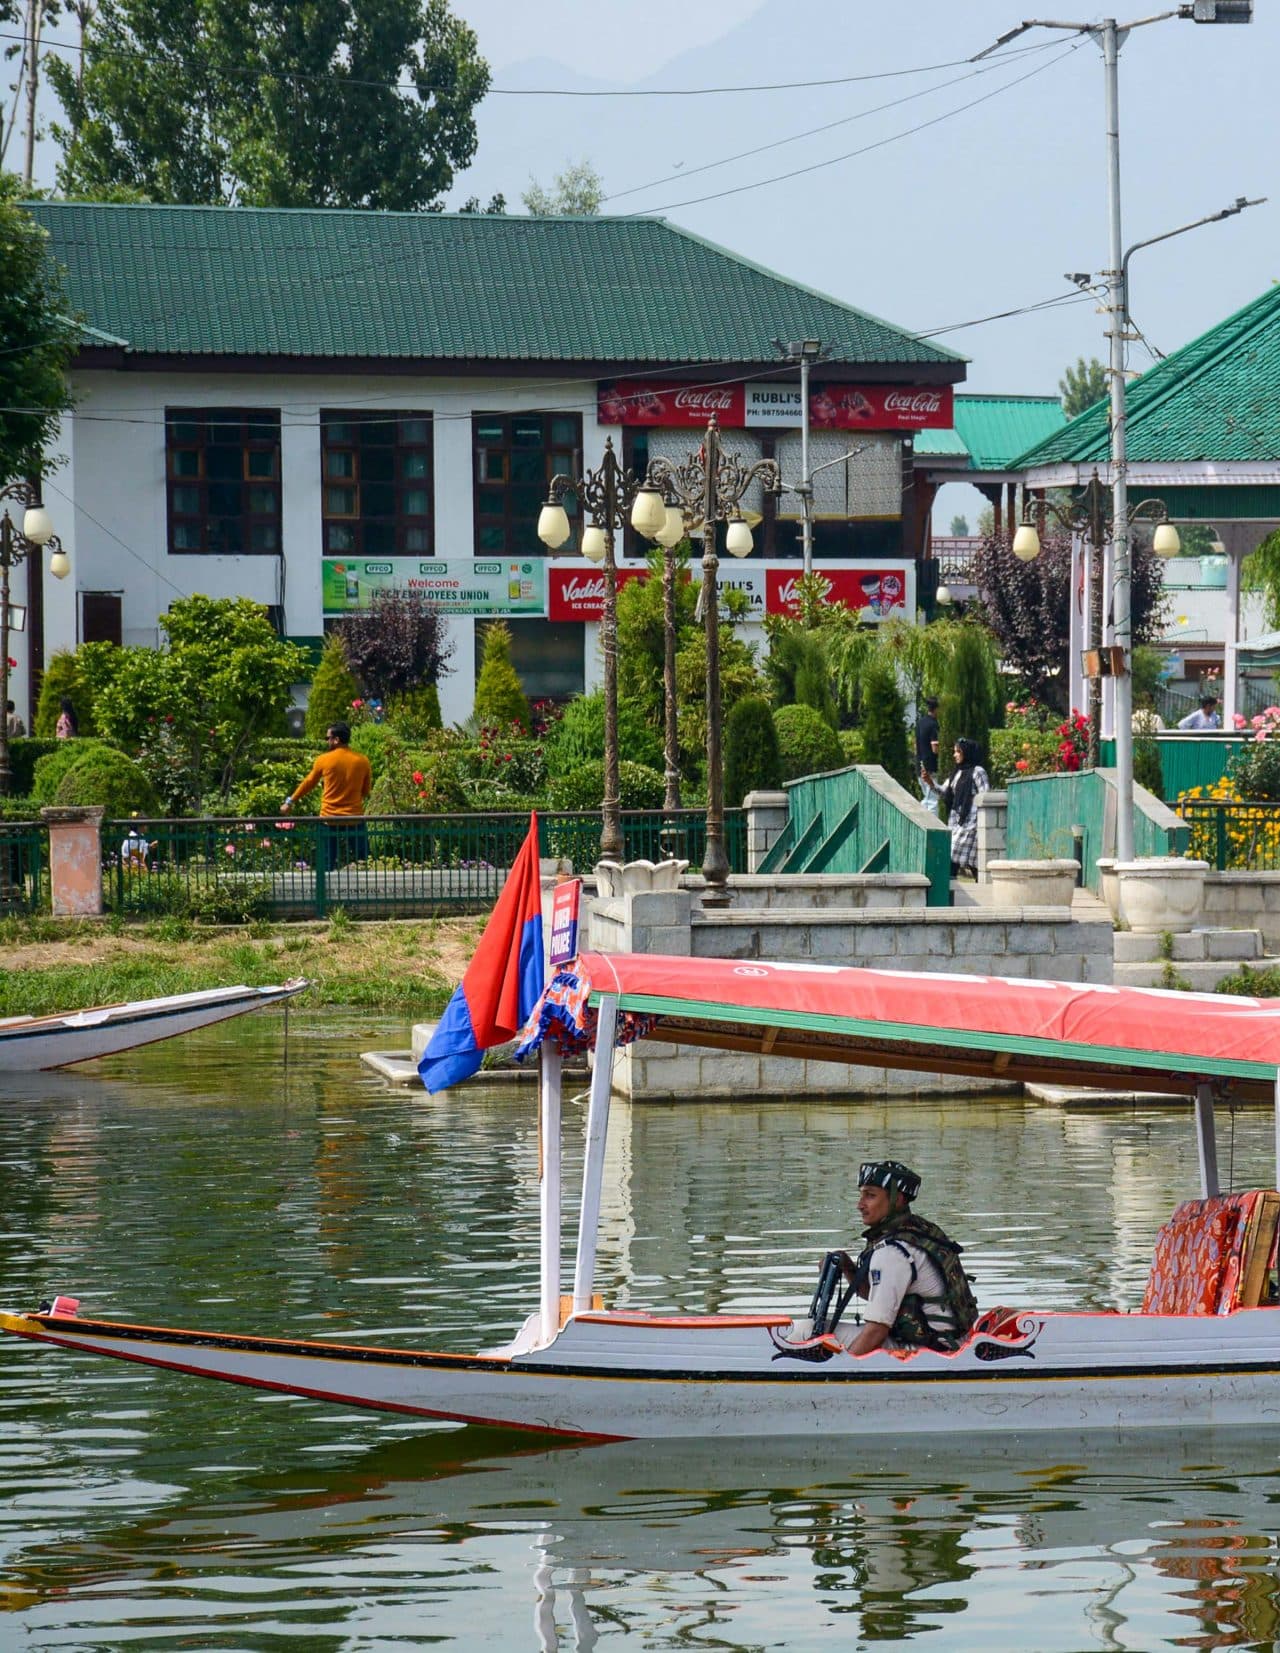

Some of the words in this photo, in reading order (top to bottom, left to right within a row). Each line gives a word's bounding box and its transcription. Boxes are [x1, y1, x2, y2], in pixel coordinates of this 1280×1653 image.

[752, 392, 802, 404] RUBLI'S
[884, 391, 943, 412] Coca-Cola
[407, 579, 460, 588] Welcome
[460, 590, 489, 600] UNION
[551, 931, 570, 957] POLICE
